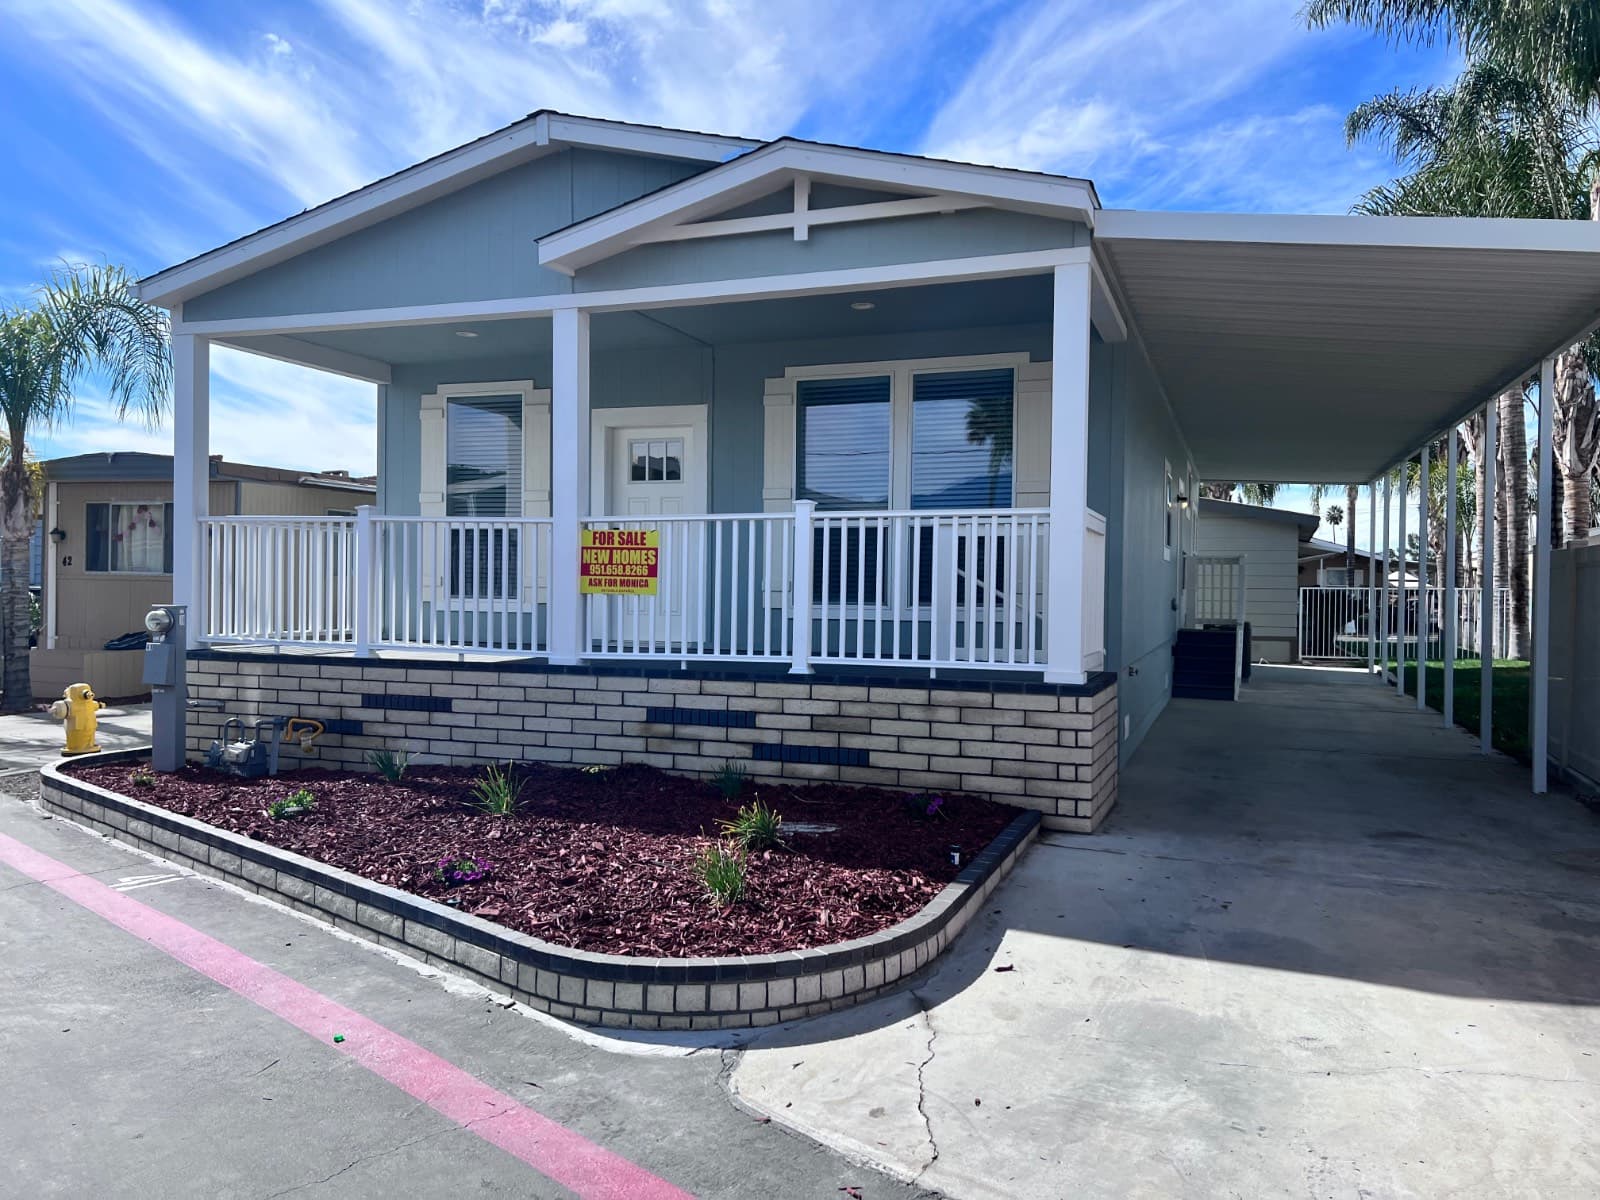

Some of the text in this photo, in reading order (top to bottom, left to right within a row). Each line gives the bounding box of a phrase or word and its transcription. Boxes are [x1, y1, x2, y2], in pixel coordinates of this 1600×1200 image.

[592, 531, 647, 545] FOR SALE
[583, 549, 656, 565] NEW HOMES
[588, 578, 649, 588] ASK FOR MONICA
